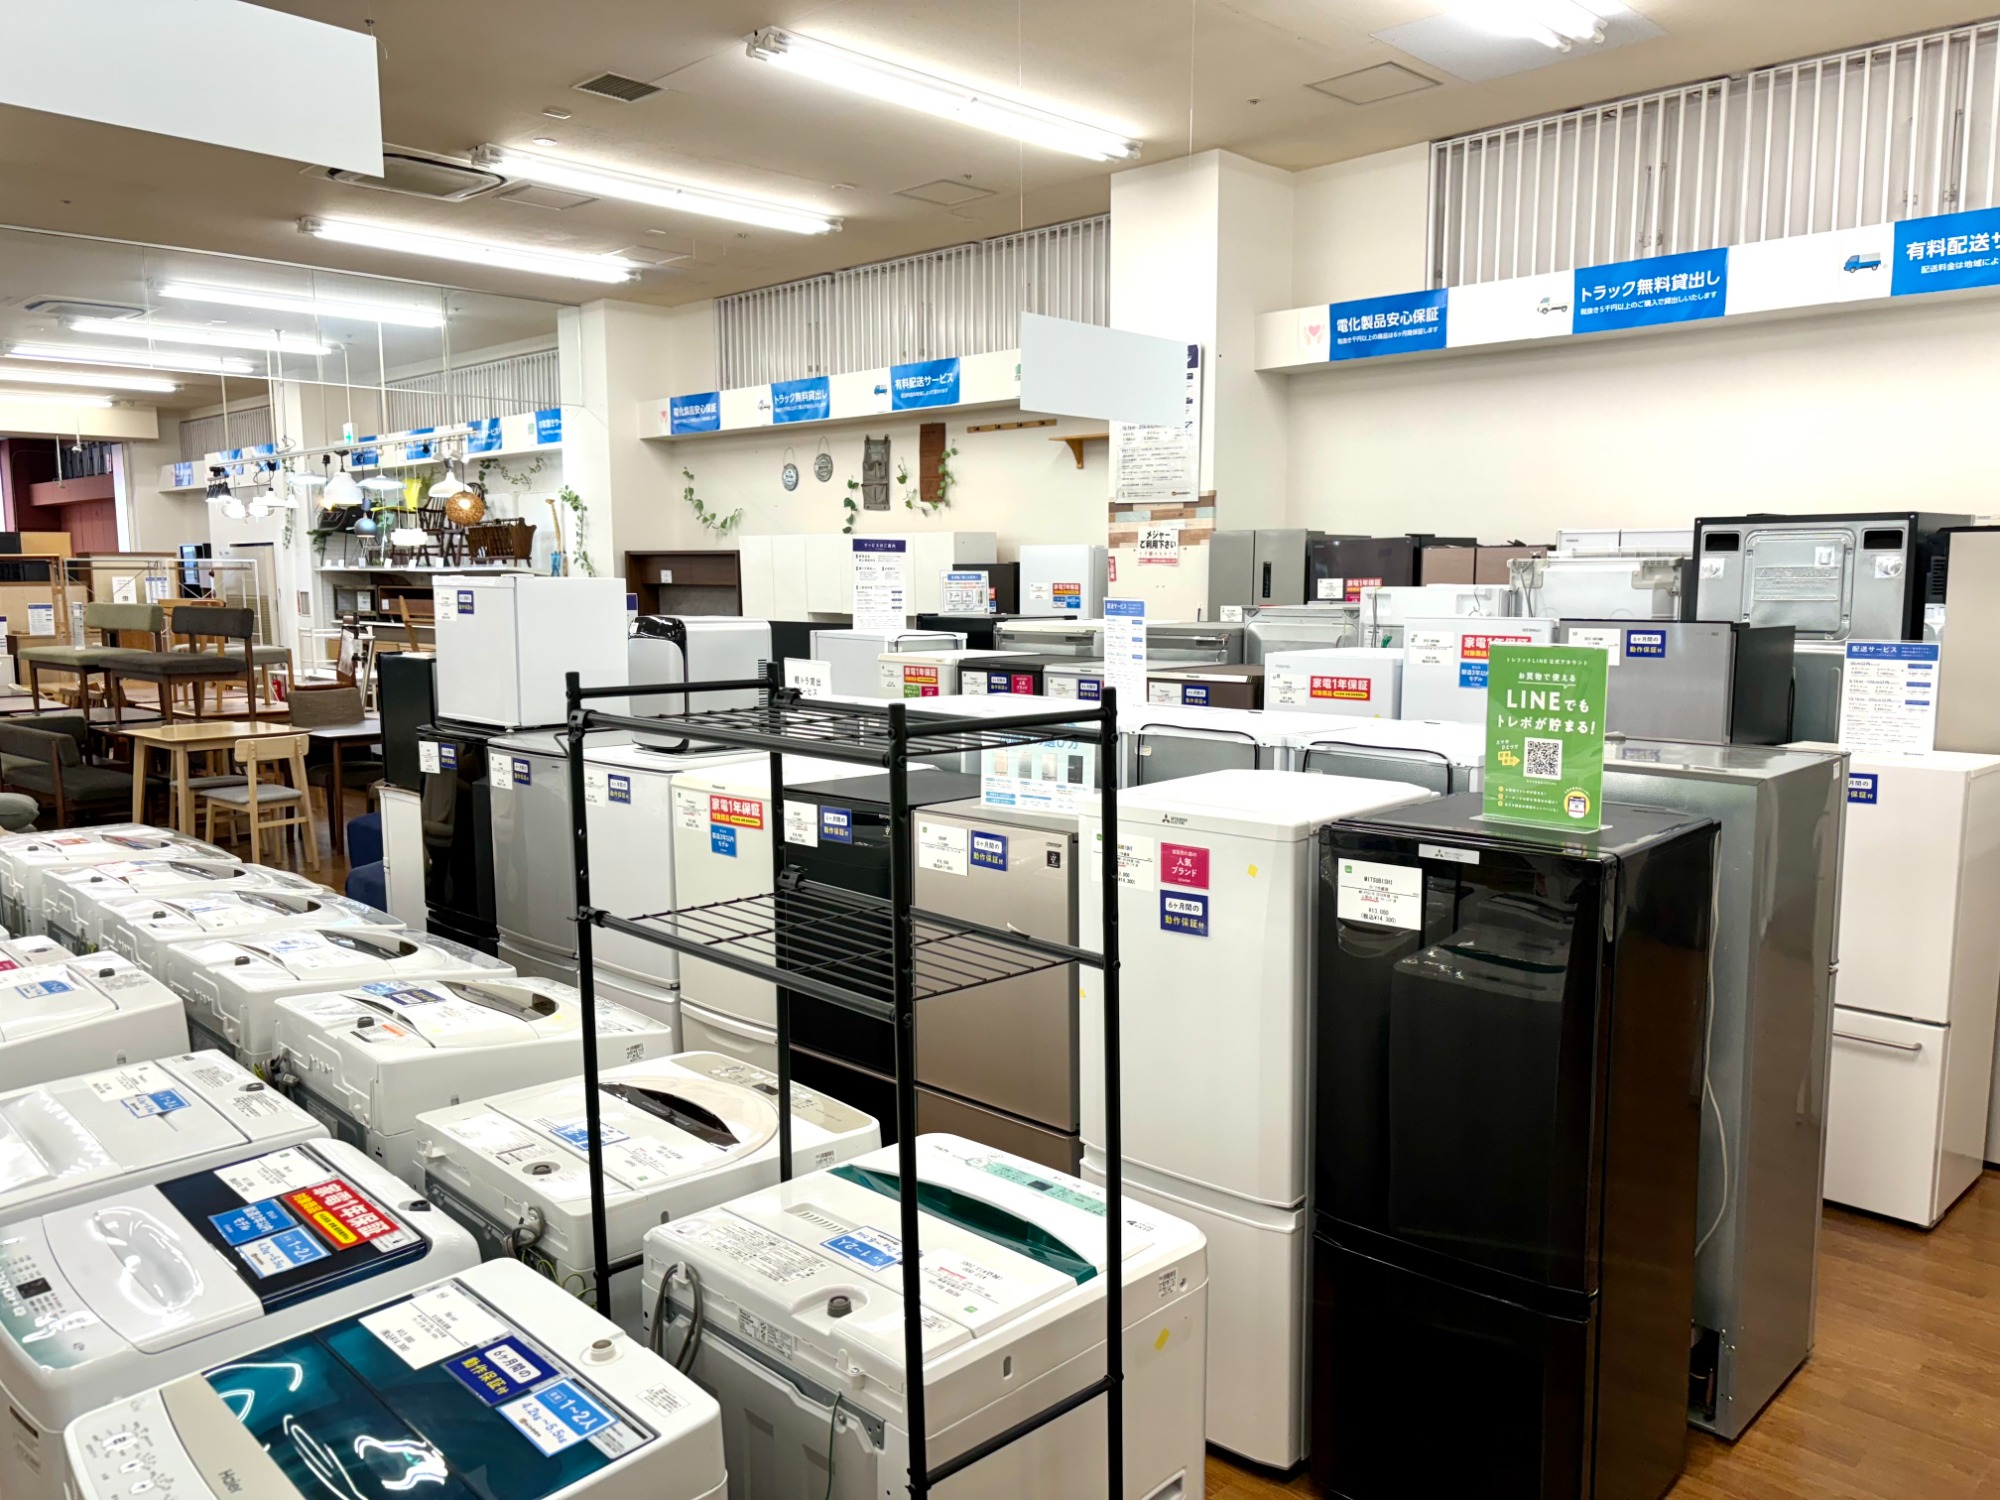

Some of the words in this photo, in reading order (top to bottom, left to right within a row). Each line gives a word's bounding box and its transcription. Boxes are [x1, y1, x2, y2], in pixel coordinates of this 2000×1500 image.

[1581, 270, 1720, 303] トラック無料貸出し
[1336, 306, 1439, 333] 電化製品安心保証
[894, 372, 954, 390] 有料配送サービス
[774, 390, 828, 405] トラック無料貸出し
[1146, 530, 1171, 540] メジャー
[1140, 540, 1177, 550] ご利用下さい
[1851, 645, 1898, 653] 配送サービス
[1312, 678, 1369, 691] 家電1年保証
[1518, 672, 1576, 683] お買物で使える
[1506, 689, 1589, 713] LINEでも
[712, 797, 761, 818] 家電1年保証
[975, 839, 999, 850] 6ヶ月間の
[973, 852, 1003, 865] 動作保証付
[1176, 857, 1192, 867] 人気
[1171, 866, 1198, 878] ブランド
[1364, 876, 1393, 885] MITSUBISHI
[1168, 901, 1200, 912] 6ヶ月間の
[1165, 915, 1205, 929] 動作保証付
[292, 1192, 324, 1215] 対象商品
[313, 1183, 391, 1239] 家電1年保証
[493, 1349, 532, 1380] 6ヶ月間の
[461, 1355, 510, 1396] 動作保証付
[218, 1468, 243, 1494] Haier
